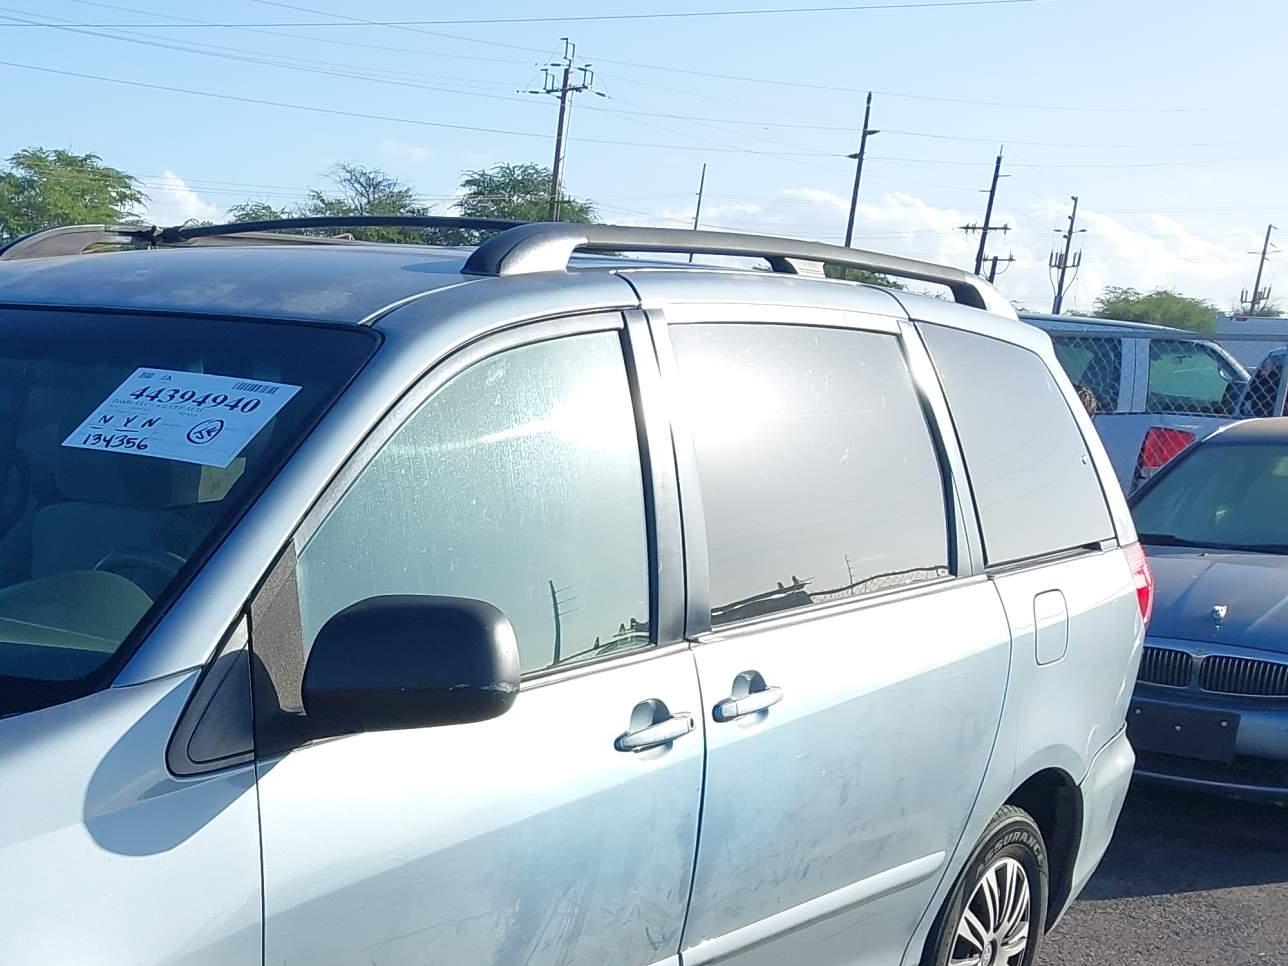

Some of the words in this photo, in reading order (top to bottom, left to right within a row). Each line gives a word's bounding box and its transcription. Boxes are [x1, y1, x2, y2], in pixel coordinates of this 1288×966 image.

[129, 386, 262, 414] 44394940
[98, 415, 114, 424] N
[123, 415, 138, 428] Y
[141, 417, 161, 428] N
[82, 433, 149, 450] 134356
